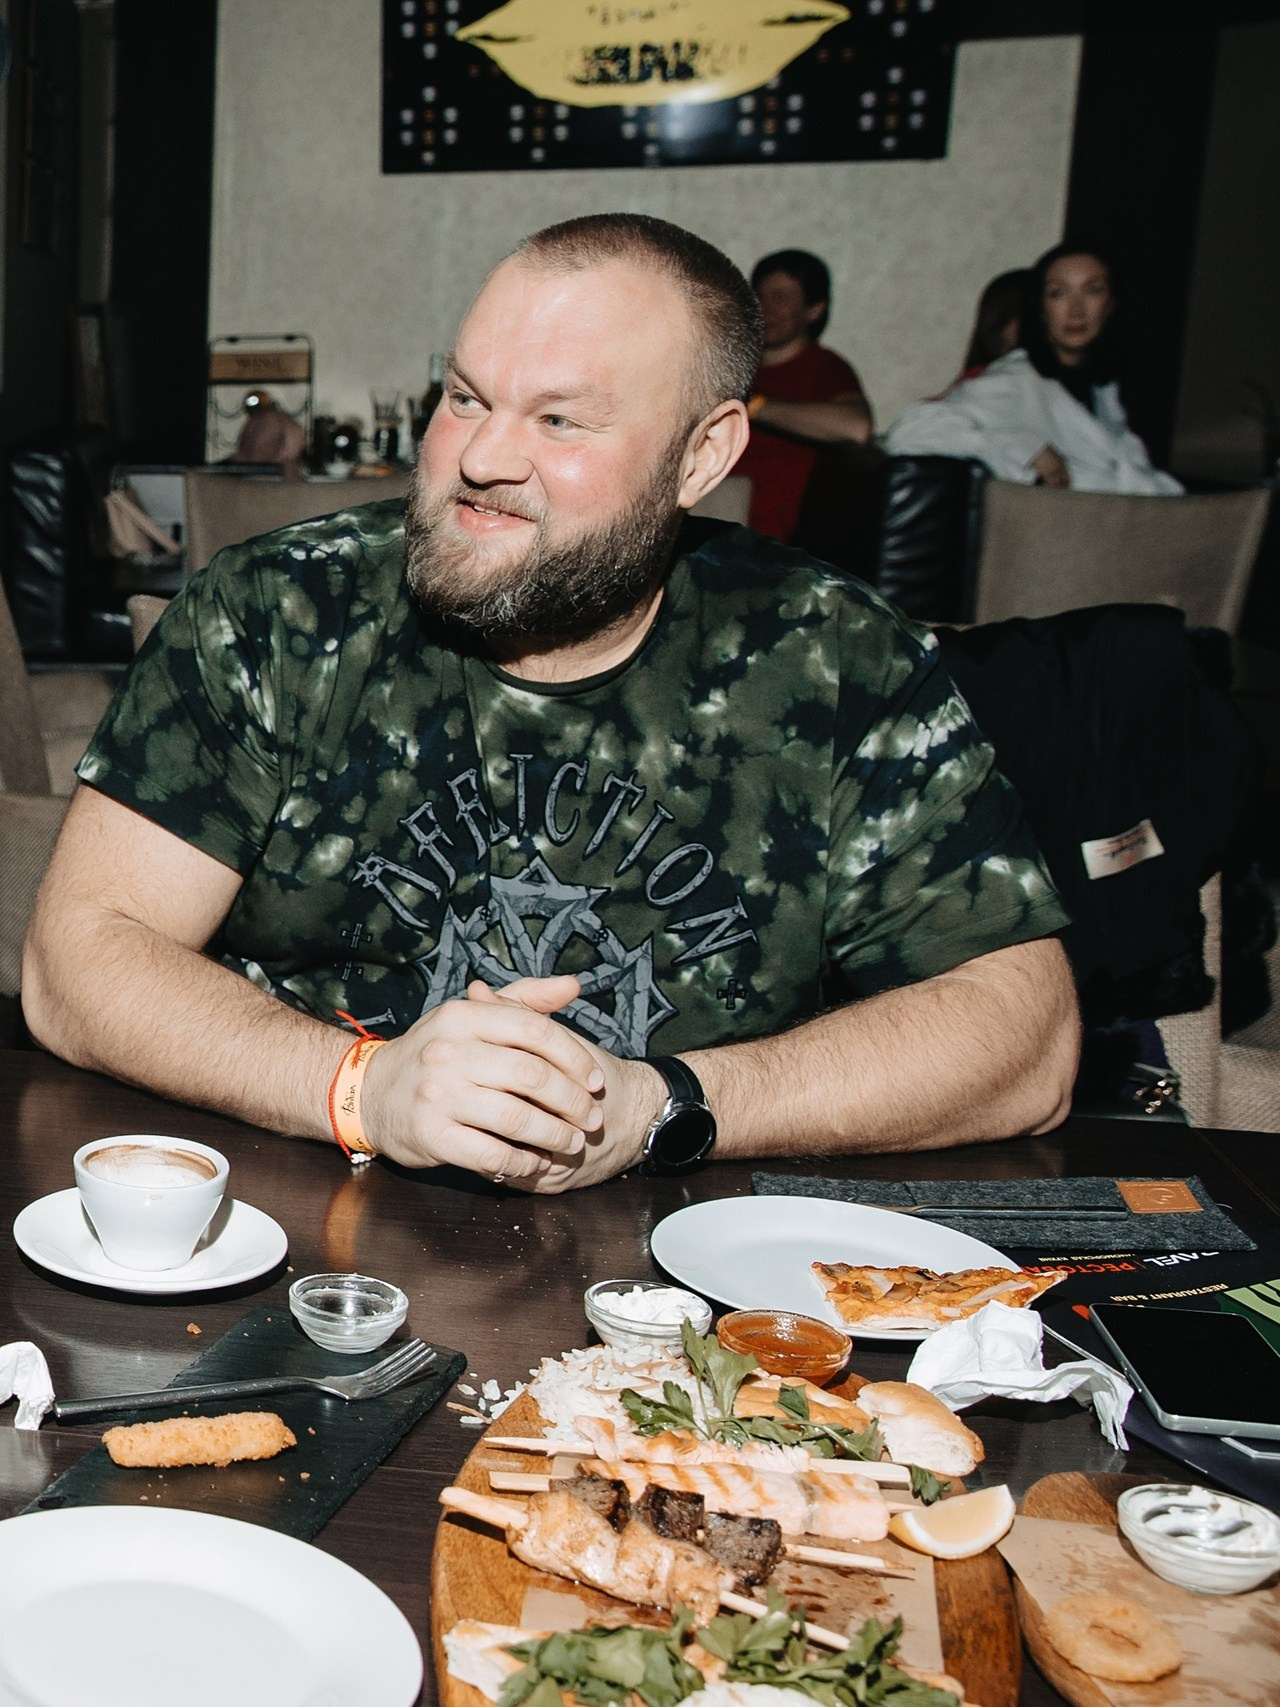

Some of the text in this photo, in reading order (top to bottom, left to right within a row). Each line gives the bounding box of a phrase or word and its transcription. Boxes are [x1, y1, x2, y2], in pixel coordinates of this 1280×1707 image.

[1143, 1251, 1219, 1267] AVEL
[1110, 1294, 1138, 1302] BAR
[1150, 1283, 1229, 1300] RESTAURANT
